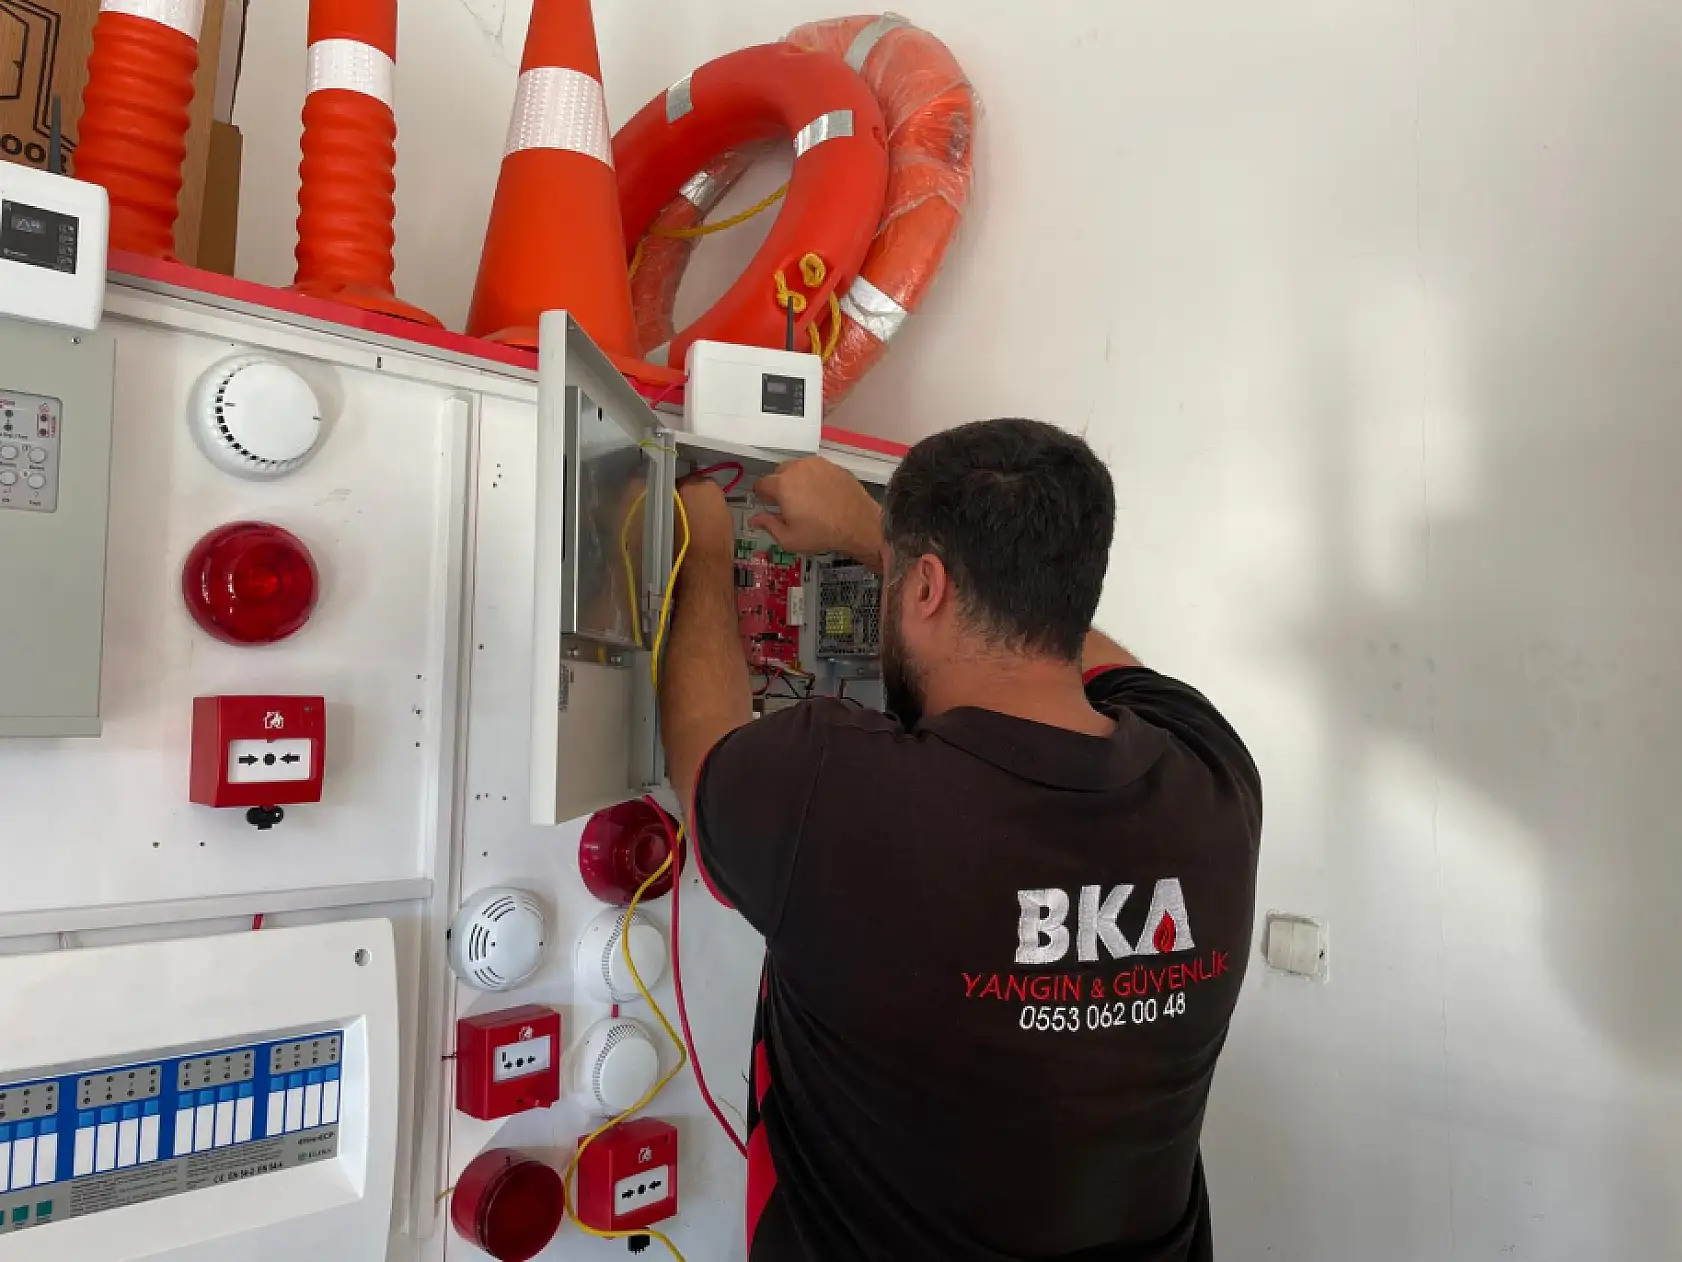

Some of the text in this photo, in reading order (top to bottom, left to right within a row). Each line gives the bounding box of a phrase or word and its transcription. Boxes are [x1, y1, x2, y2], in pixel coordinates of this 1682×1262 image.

[1014, 877, 1196, 964] BKA
[962, 950, 1229, 1001] YANGIN & GÜVENLİK
[1019, 992, 1186, 1032] 0553 062 00 48
